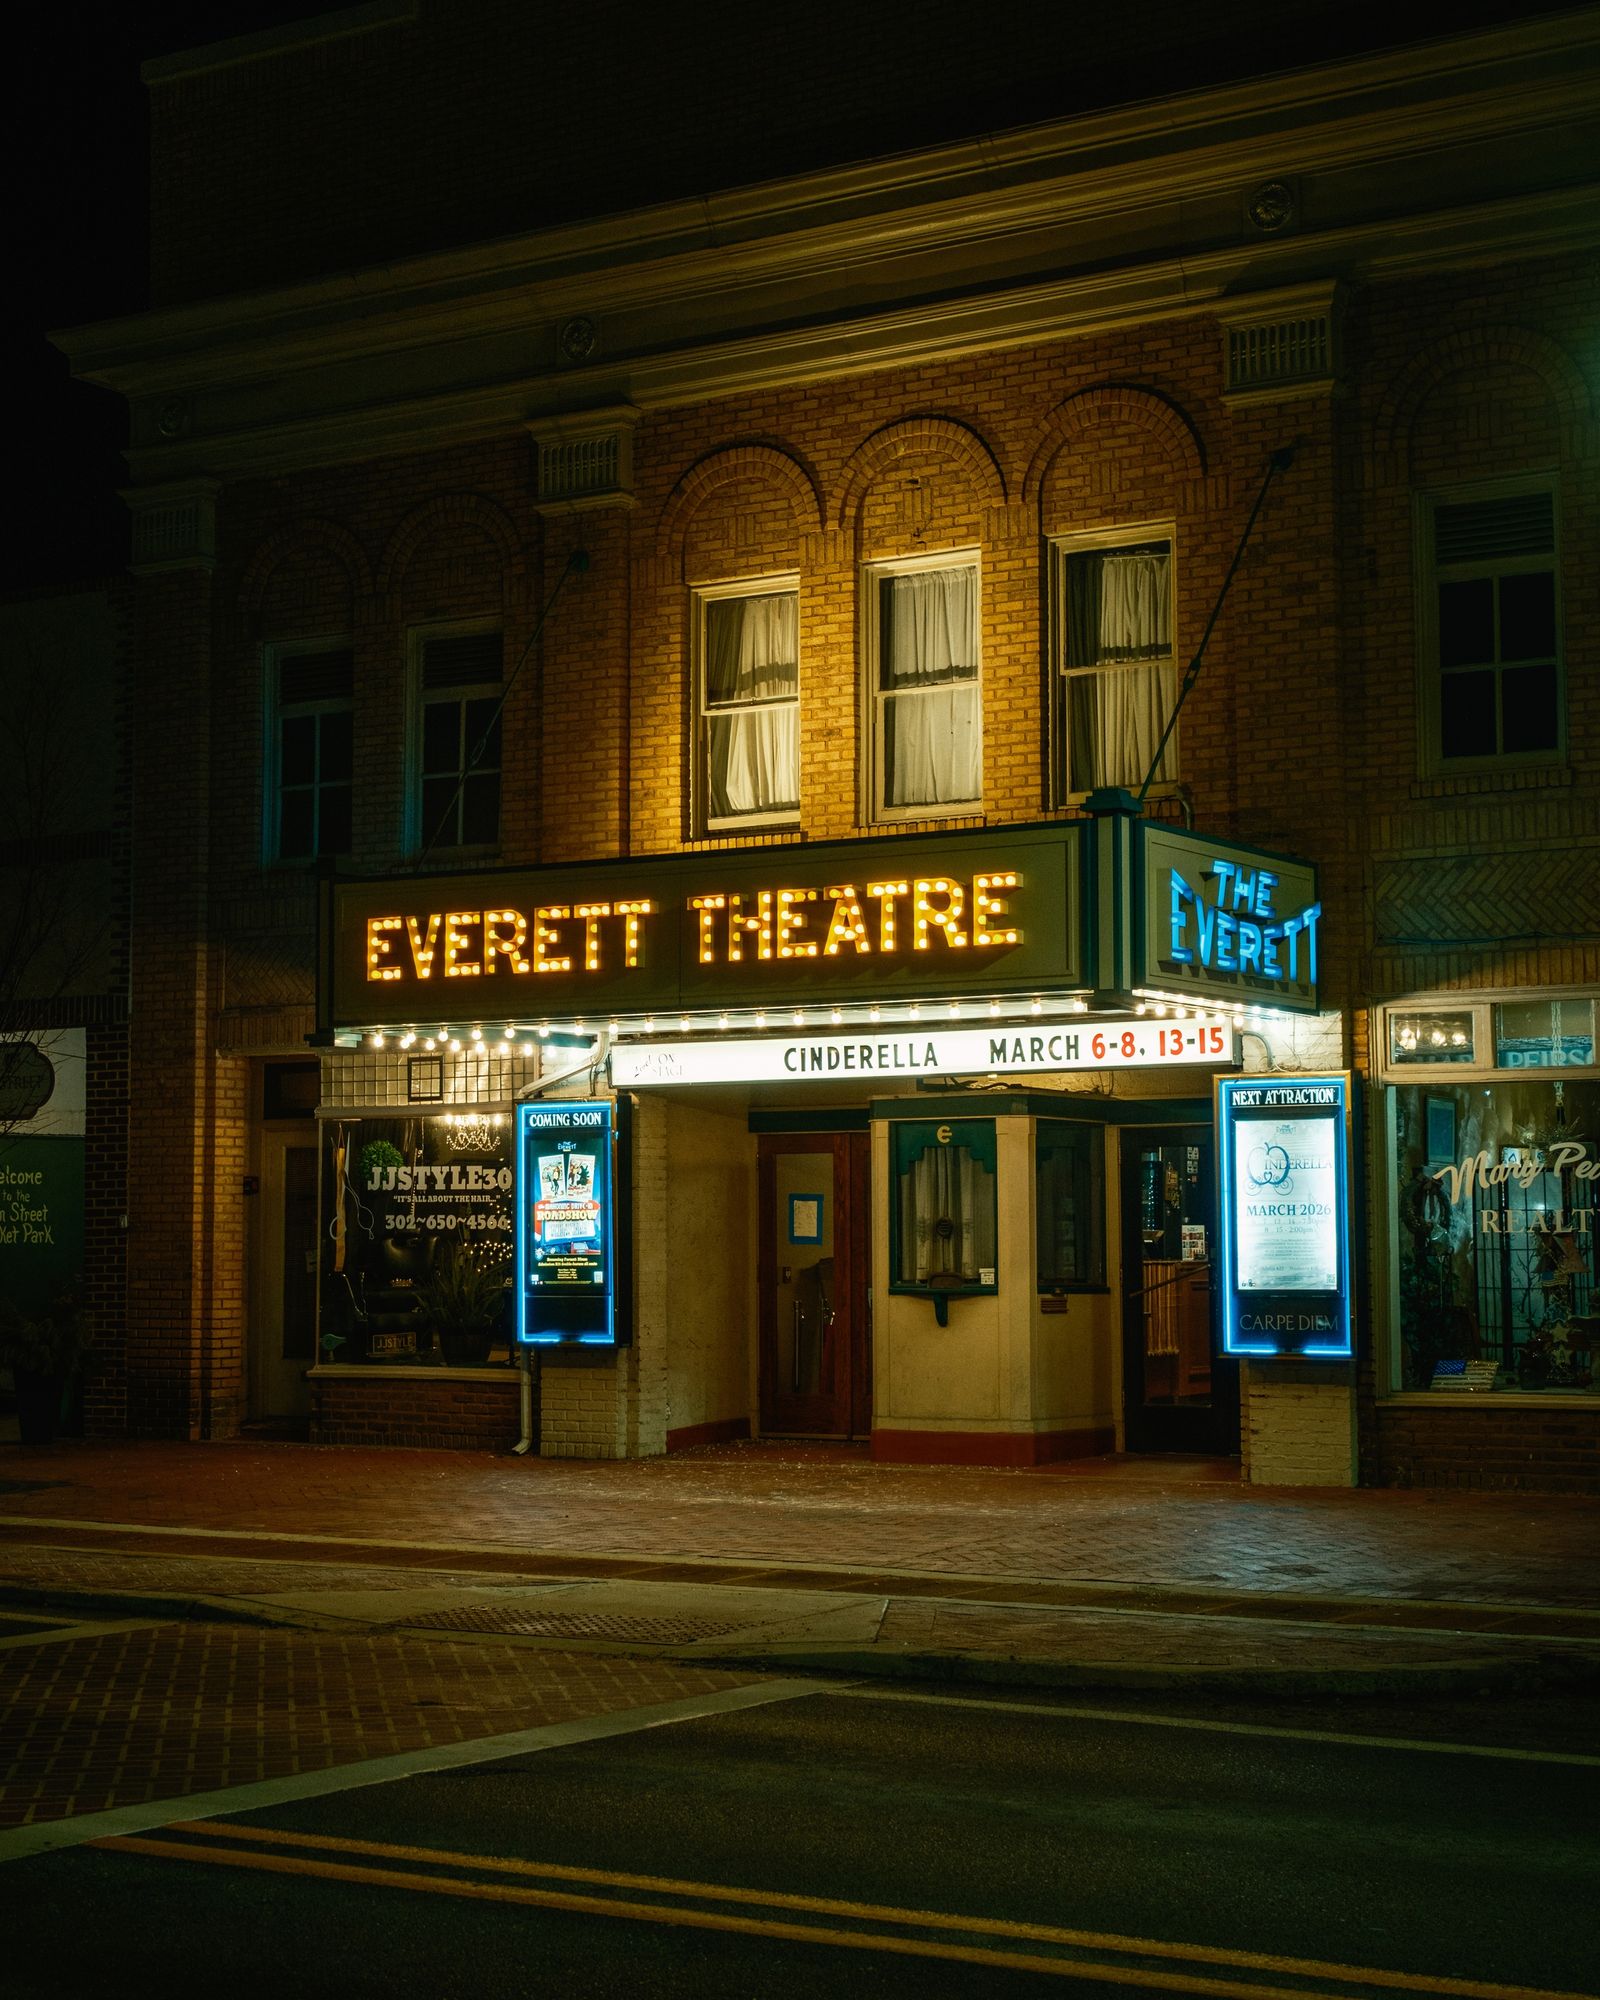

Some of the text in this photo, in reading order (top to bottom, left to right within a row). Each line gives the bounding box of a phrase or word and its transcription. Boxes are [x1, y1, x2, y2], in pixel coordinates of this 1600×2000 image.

[1212, 860, 1280, 919] THE
[366, 871, 1024, 982] EVERETT THEATRE
[1171, 867, 1322, 985] EVERETT
[783, 1042, 938, 1073] CINDERELLA
[989, 1034, 1080, 1064] MARCH
[1158, 1026, 1225, 1056] 13-15
[1232, 1088, 1334, 1105] NEXT ATTRACTION
[529, 1112, 602, 1127] COMING SOON
[367, 1165, 513, 1190] JJSTYLE30
[1432, 1150, 1544, 1205] Mary
[17, 1189, 31, 1202] the
[413, 1195, 427, 1203] ALL
[428, 1195, 454, 1203] ABOUT
[455, 1195, 471, 1203] THE
[10, 1202, 48, 1222] Street
[536, 1209, 599, 1221] ROADSHOW
[1246, 1203, 1332, 1216] MARCH 2026
[1481, 1207, 1600, 1233] REALT
[1240, 1314, 1339, 1331] CARPE DIEM
